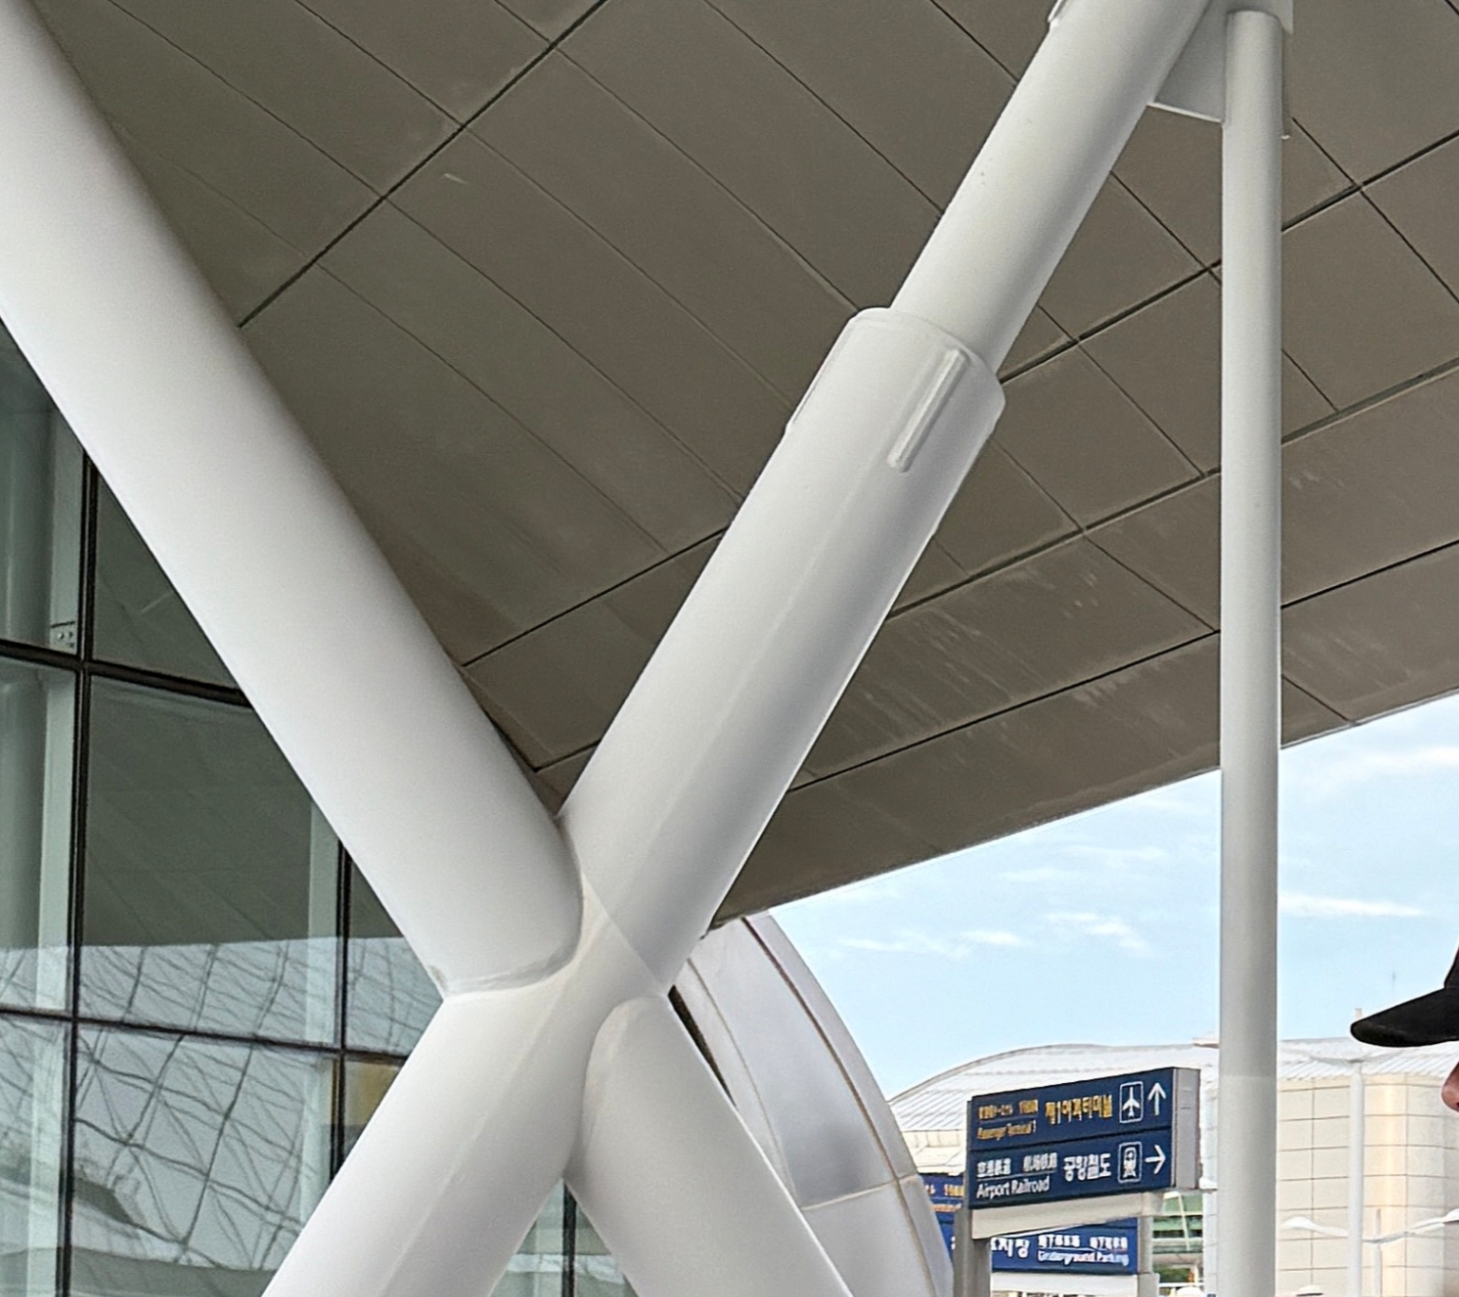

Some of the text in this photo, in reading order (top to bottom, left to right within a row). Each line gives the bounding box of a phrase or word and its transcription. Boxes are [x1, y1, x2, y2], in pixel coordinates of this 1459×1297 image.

[1063, 1153, 1112, 1182] 공항철도
[976, 1183, 1010, 1199] Airport
[1011, 1175, 1050, 1194] Railroad
